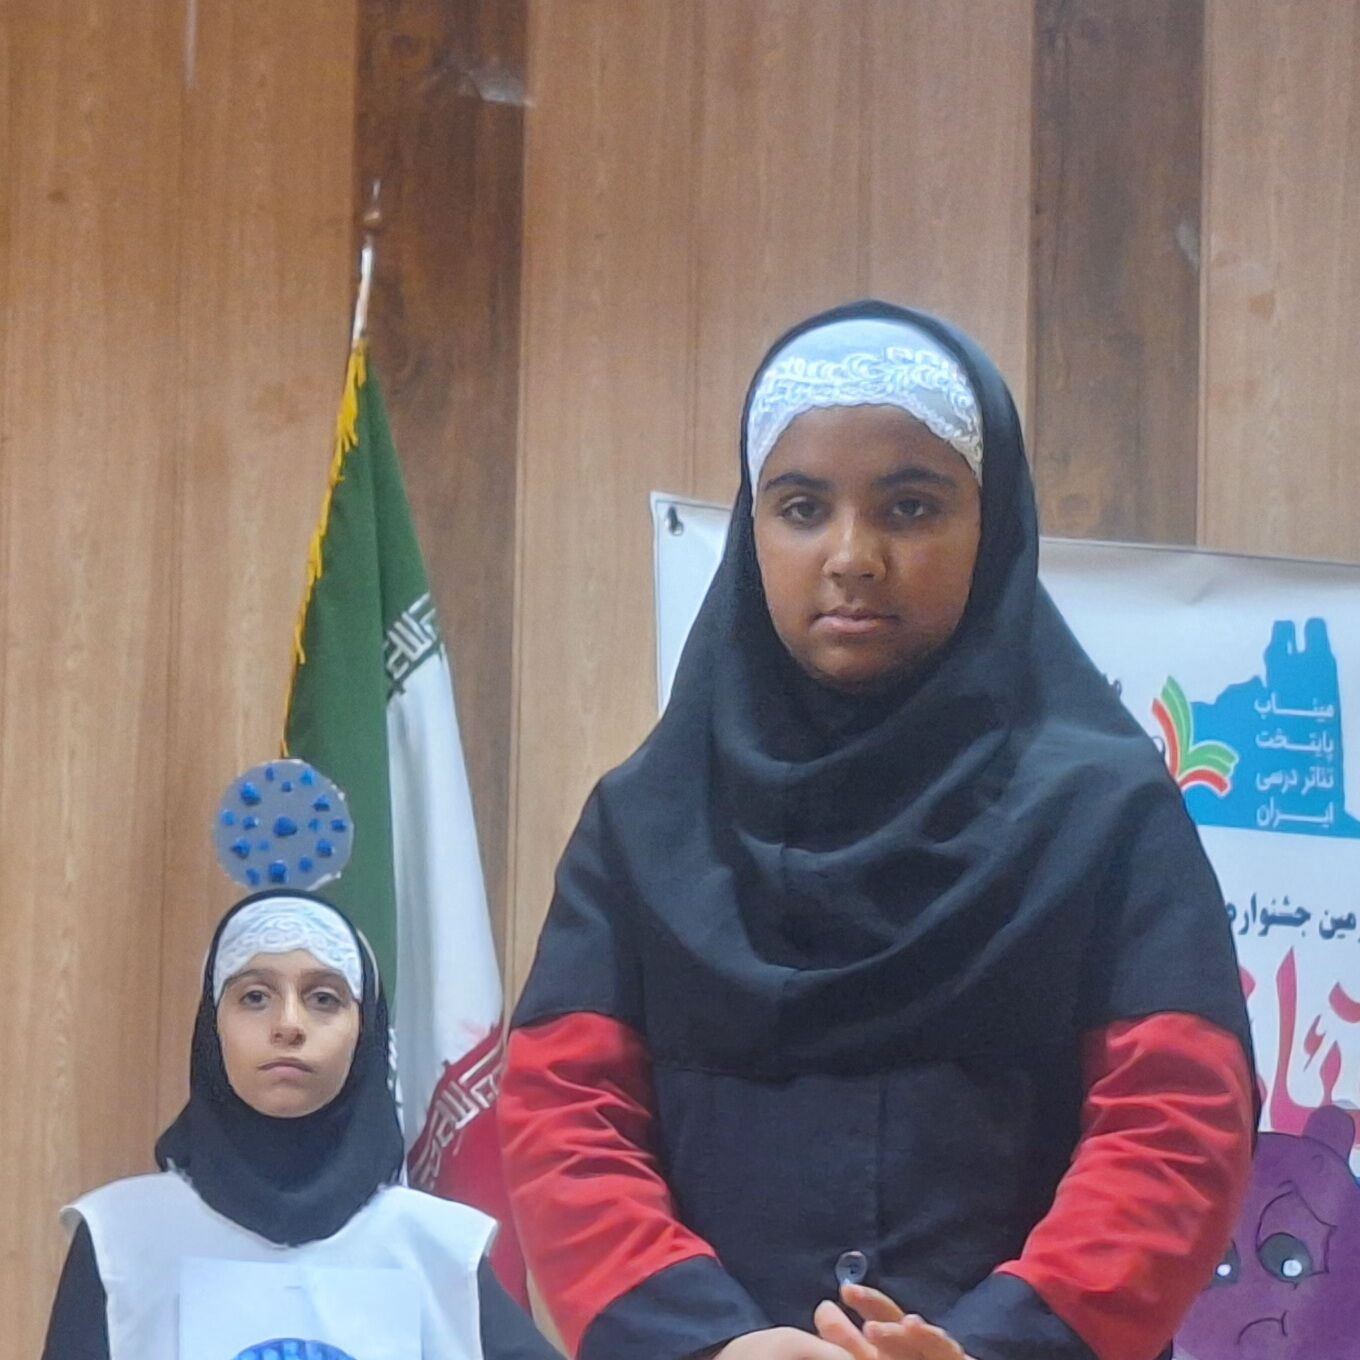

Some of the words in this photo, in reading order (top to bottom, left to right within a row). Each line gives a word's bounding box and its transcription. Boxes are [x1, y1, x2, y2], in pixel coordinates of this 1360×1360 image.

[1254, 690, 1335, 722] میناب
[1254, 727, 1334, 762] پایتخت
[1255, 768, 1298, 792] درسی
[1301, 765, 1334, 795] تئاتر
[1255, 796, 1335, 829] ایران
